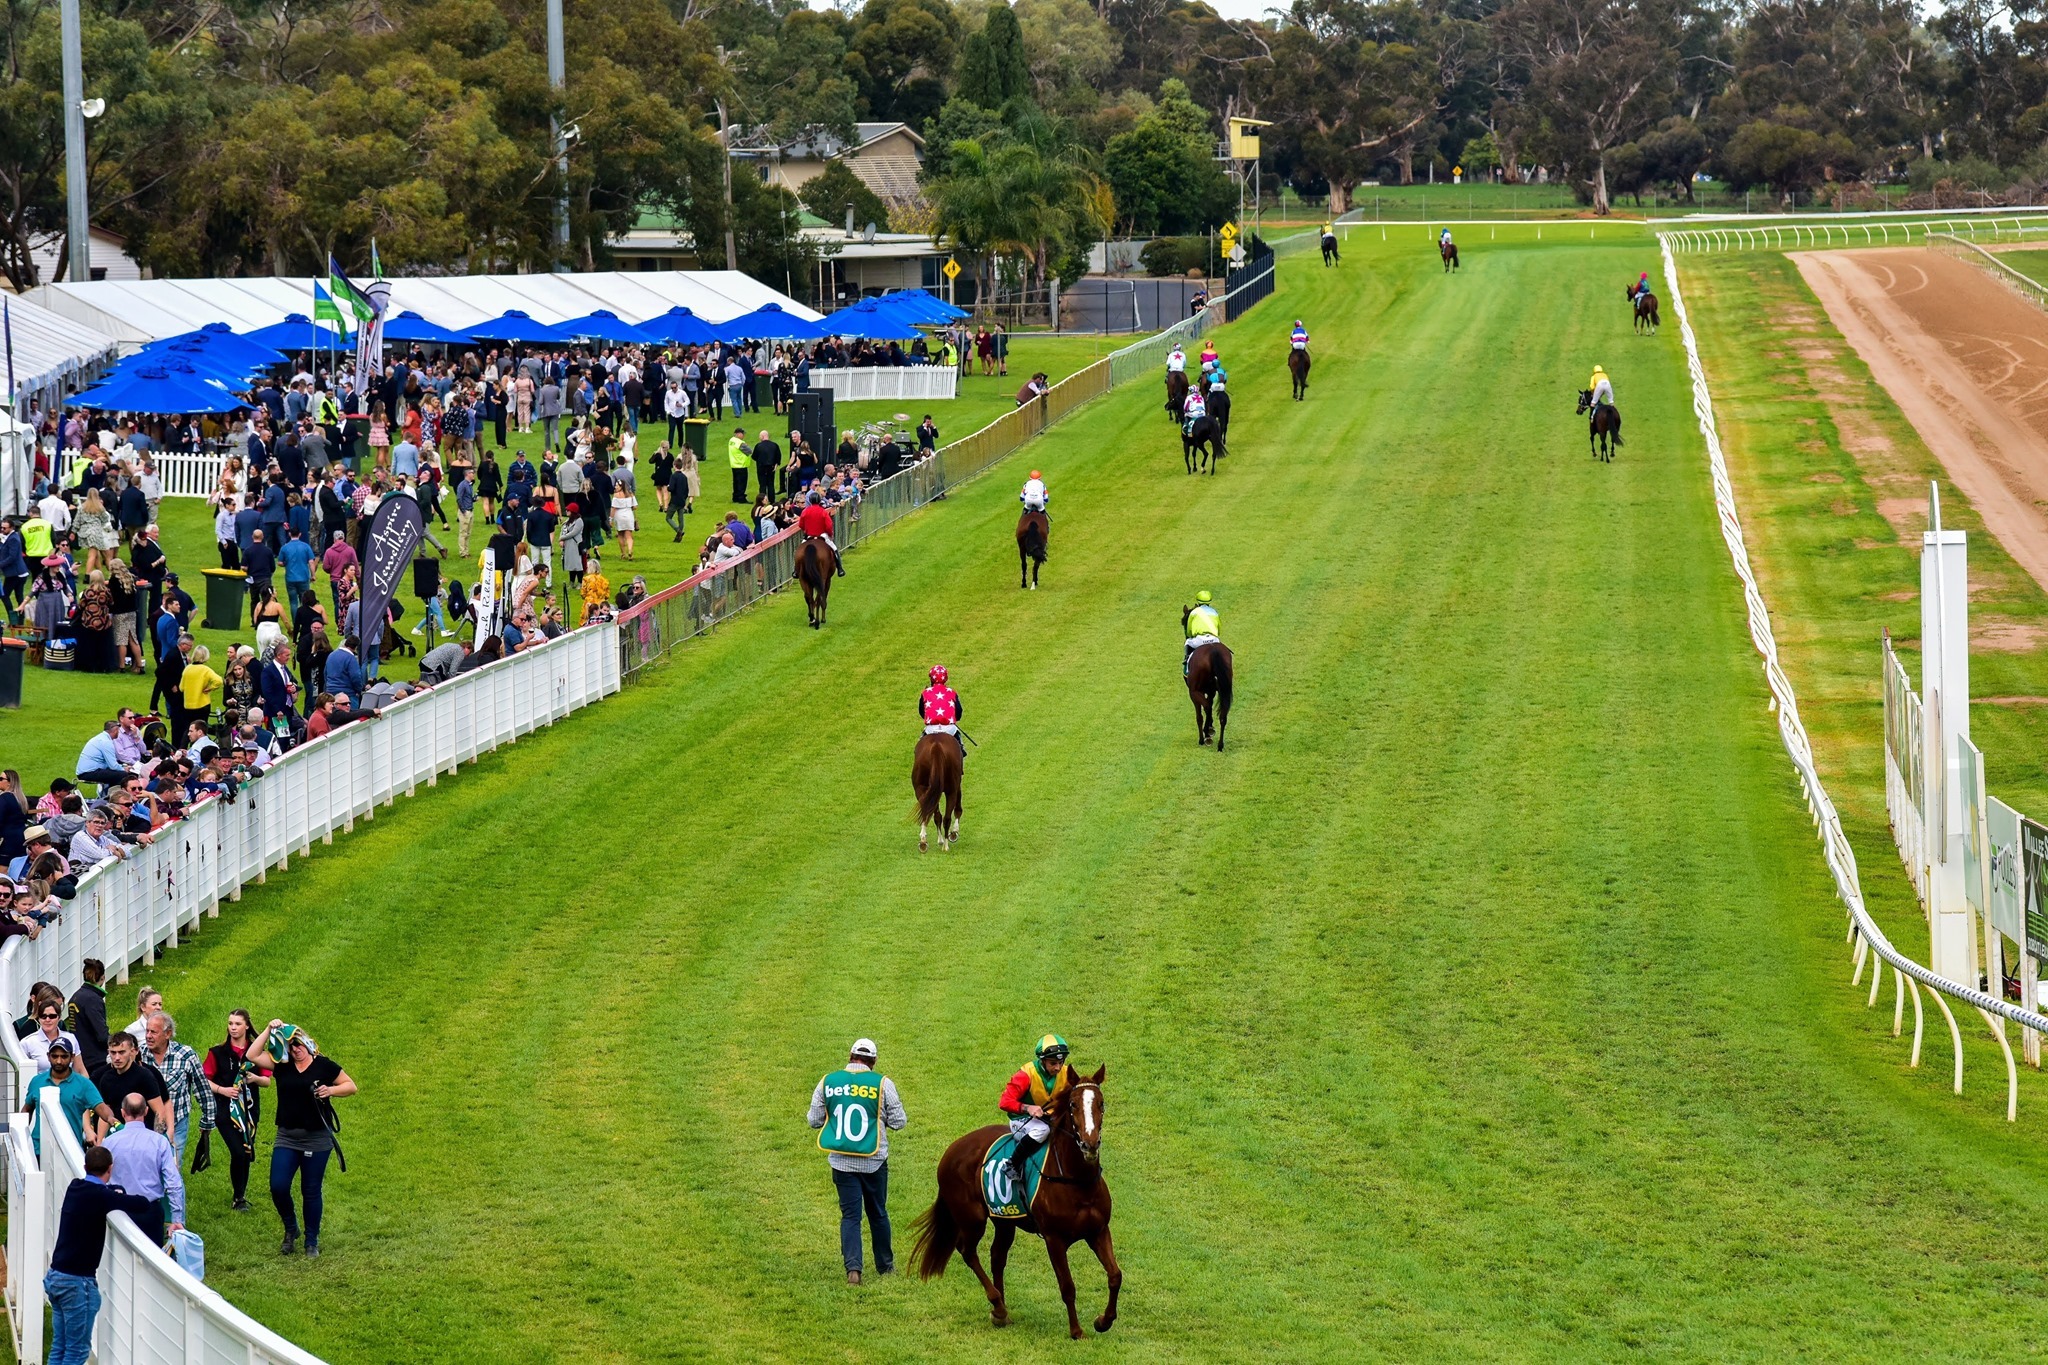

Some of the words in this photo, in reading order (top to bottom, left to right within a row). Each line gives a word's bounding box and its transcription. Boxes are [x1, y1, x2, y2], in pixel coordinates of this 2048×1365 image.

[27, 525, 45, 534] SECURITY
[372, 502, 401, 562] Aspire
[373, 519, 418, 596] Jewellery
[825, 1084, 878, 1099] bet365
[833, 1103, 869, 1142] 10
[985, 1158, 1013, 1204] 10
